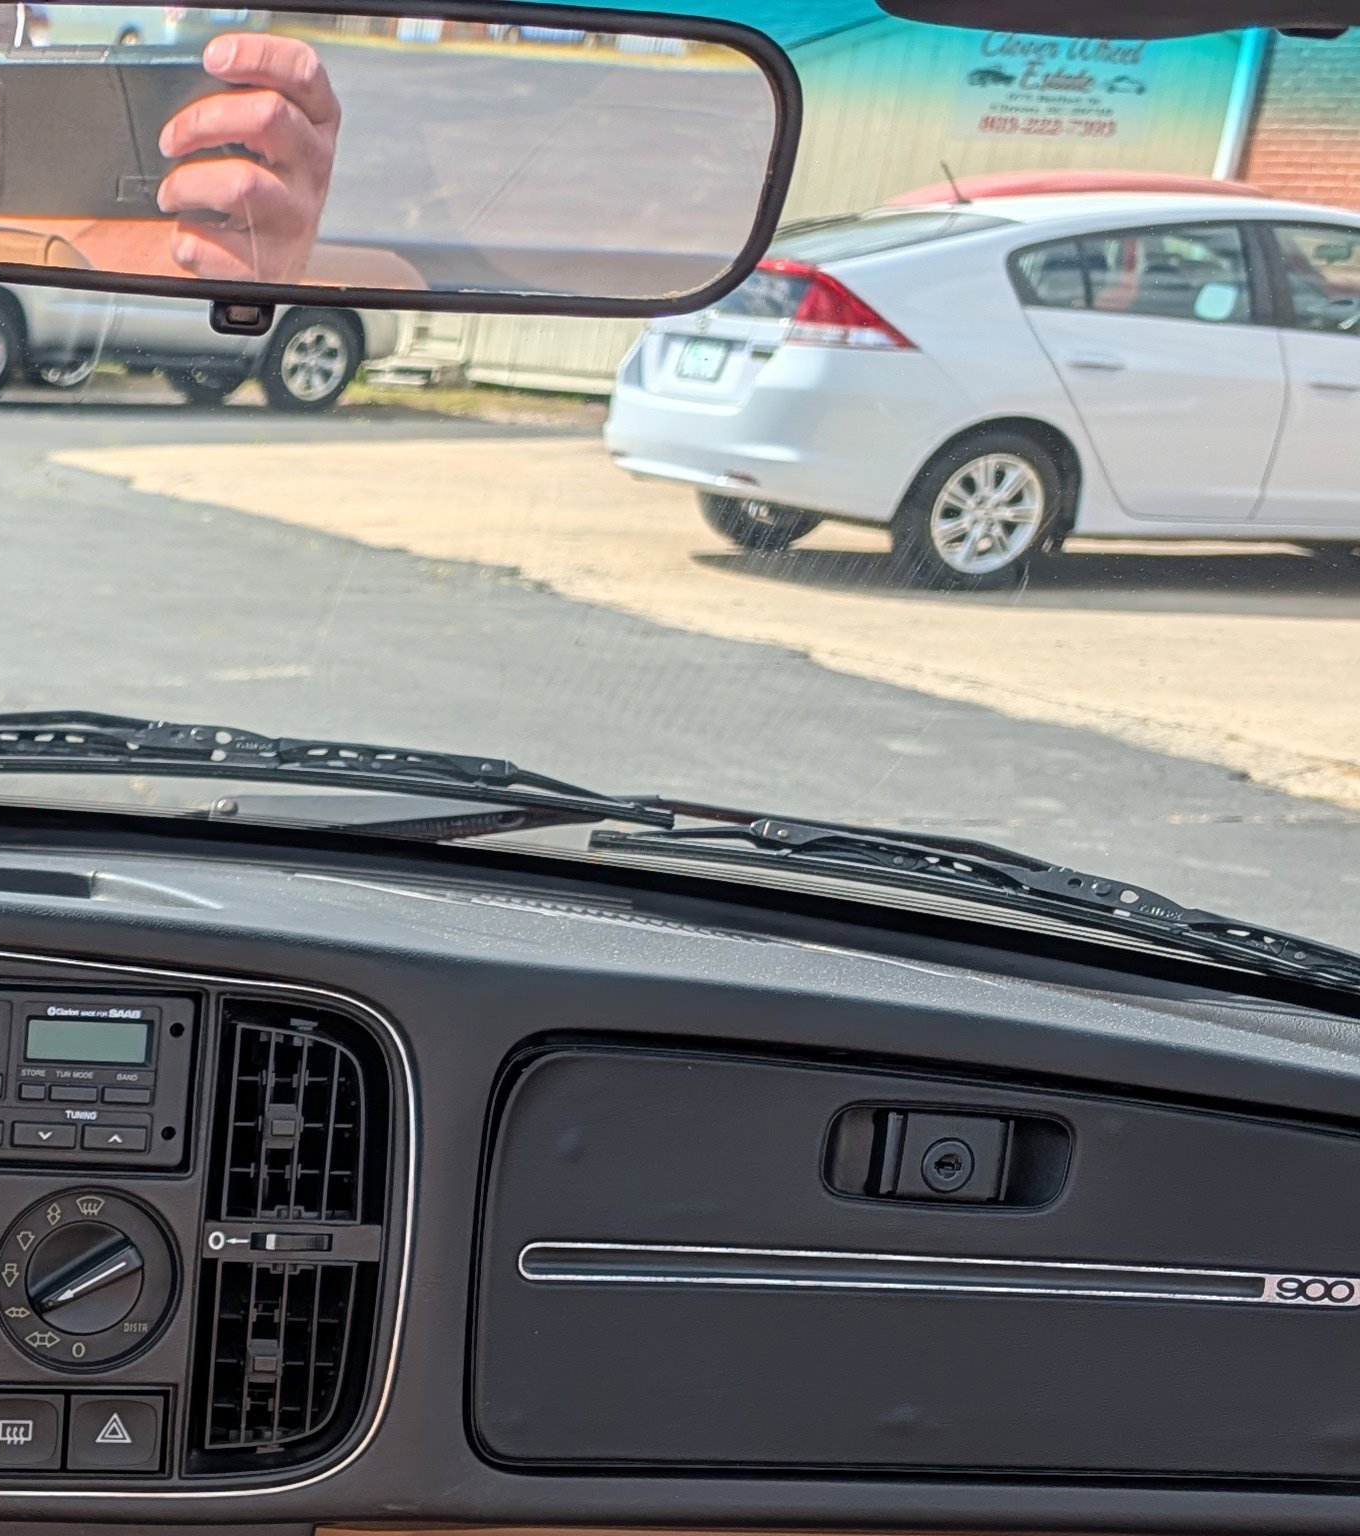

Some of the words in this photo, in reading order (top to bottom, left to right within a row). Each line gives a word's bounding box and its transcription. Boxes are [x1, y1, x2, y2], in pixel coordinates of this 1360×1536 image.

[108, 1008, 141, 1019] SAAB
[21, 1068, 46, 1078] STORE
[72, 1071, 94, 1079] MODE
[116, 1073, 138, 1081] BAND
[65, 1110, 98, 1120] TUNING
[1275, 1277, 1355, 1303] 900
